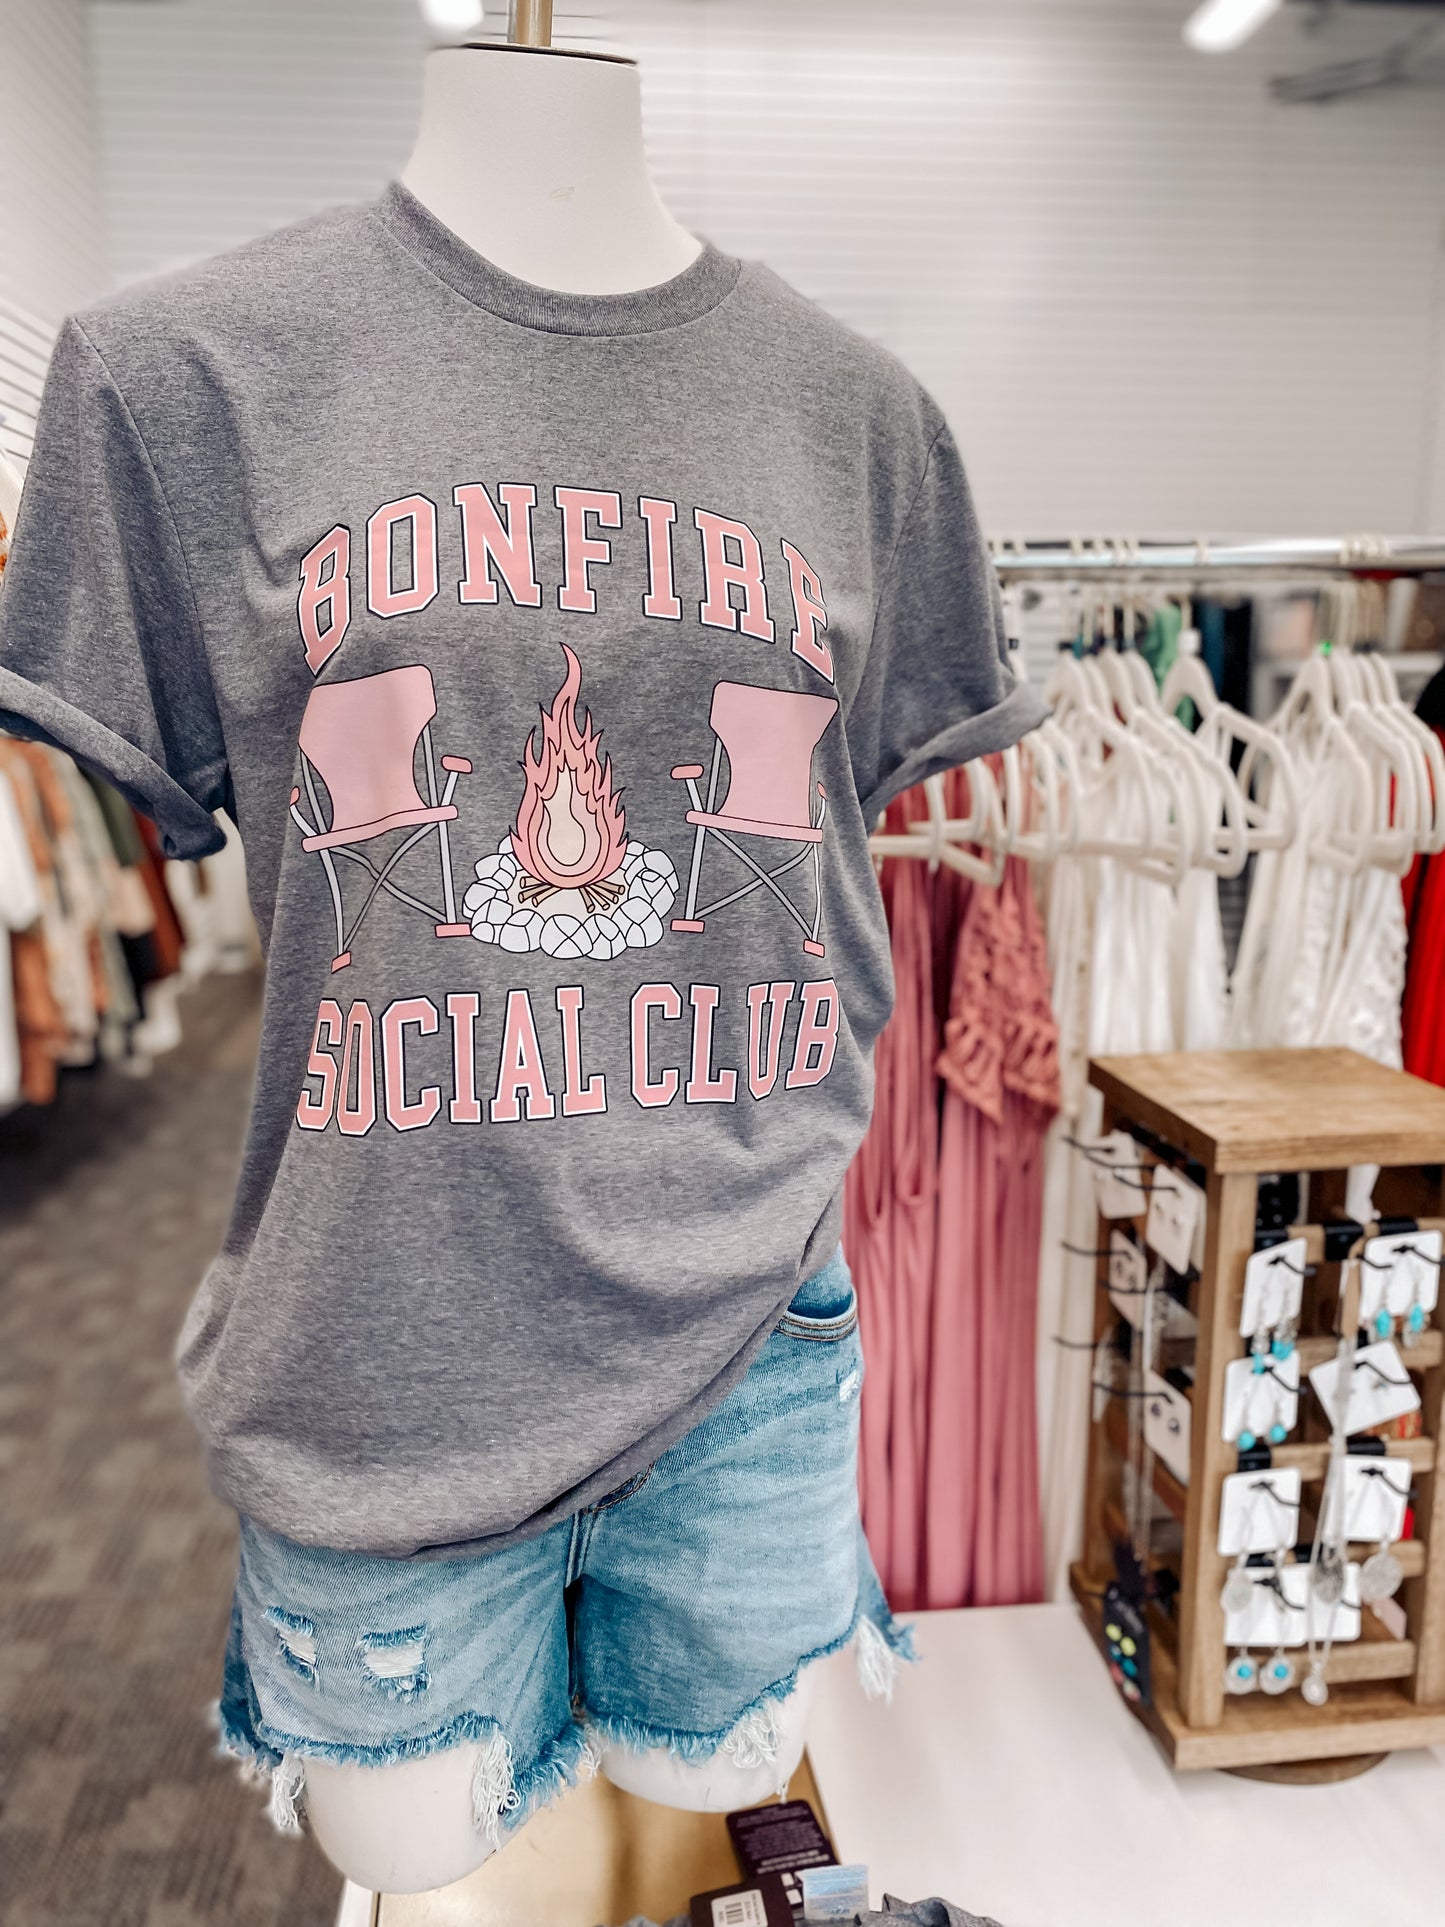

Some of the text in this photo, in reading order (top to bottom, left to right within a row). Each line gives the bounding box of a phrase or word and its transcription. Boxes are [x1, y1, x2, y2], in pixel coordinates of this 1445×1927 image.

[298, 482, 836, 684] BONFIRE
[296, 978, 841, 1136] SOCIAL CLUB
